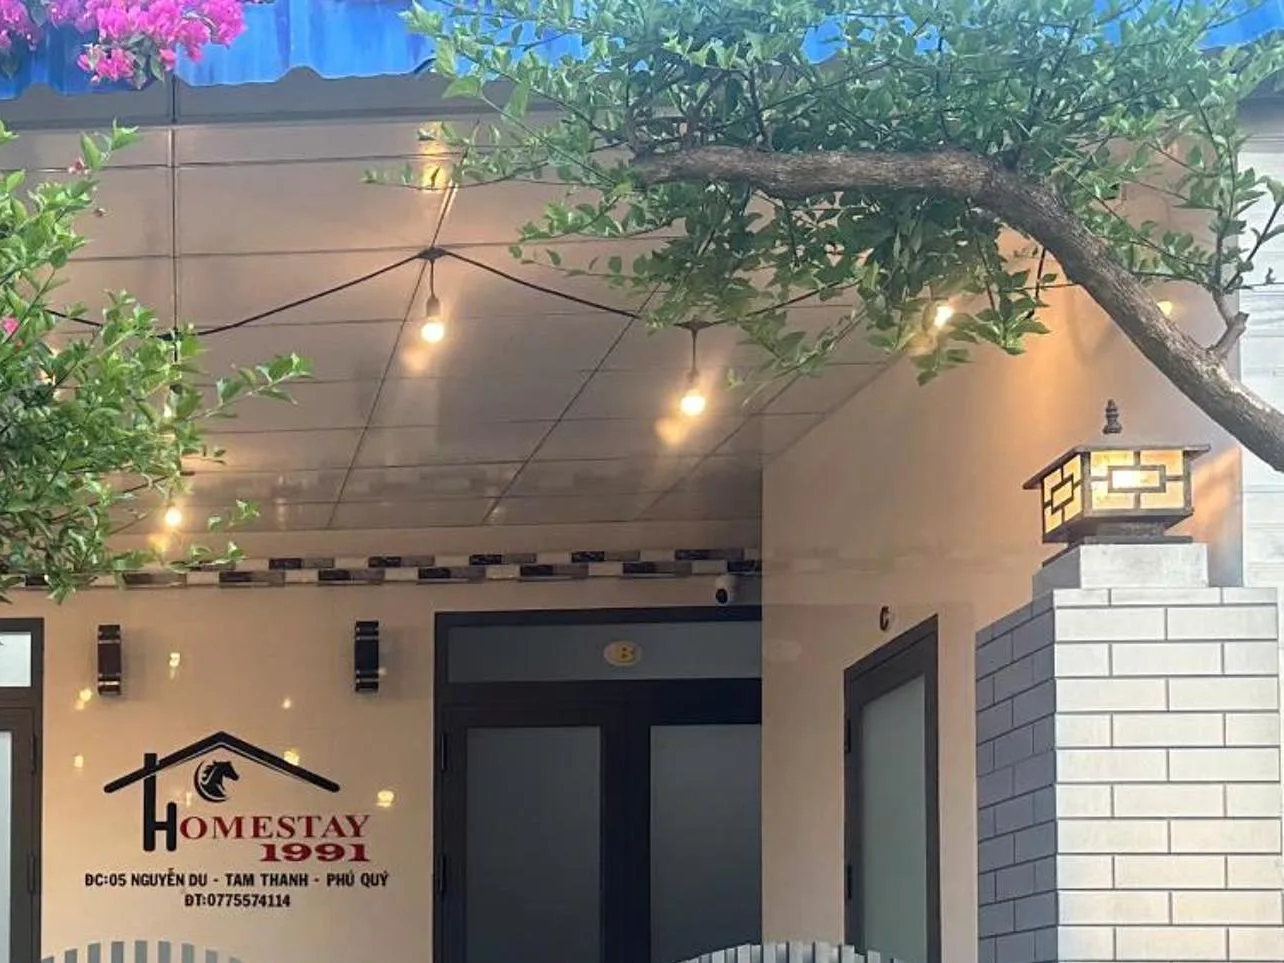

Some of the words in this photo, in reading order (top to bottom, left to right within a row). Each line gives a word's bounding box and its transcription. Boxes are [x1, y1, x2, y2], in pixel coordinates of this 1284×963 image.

[143, 773, 370, 852] HOMESTAY
[259, 843, 371, 862] 1991
[84, 873, 127, 887] ĐC:05
[188, 873, 208, 887] DU
[224, 873, 255, 887] TAM
[259, 873, 309, 887] THANH
